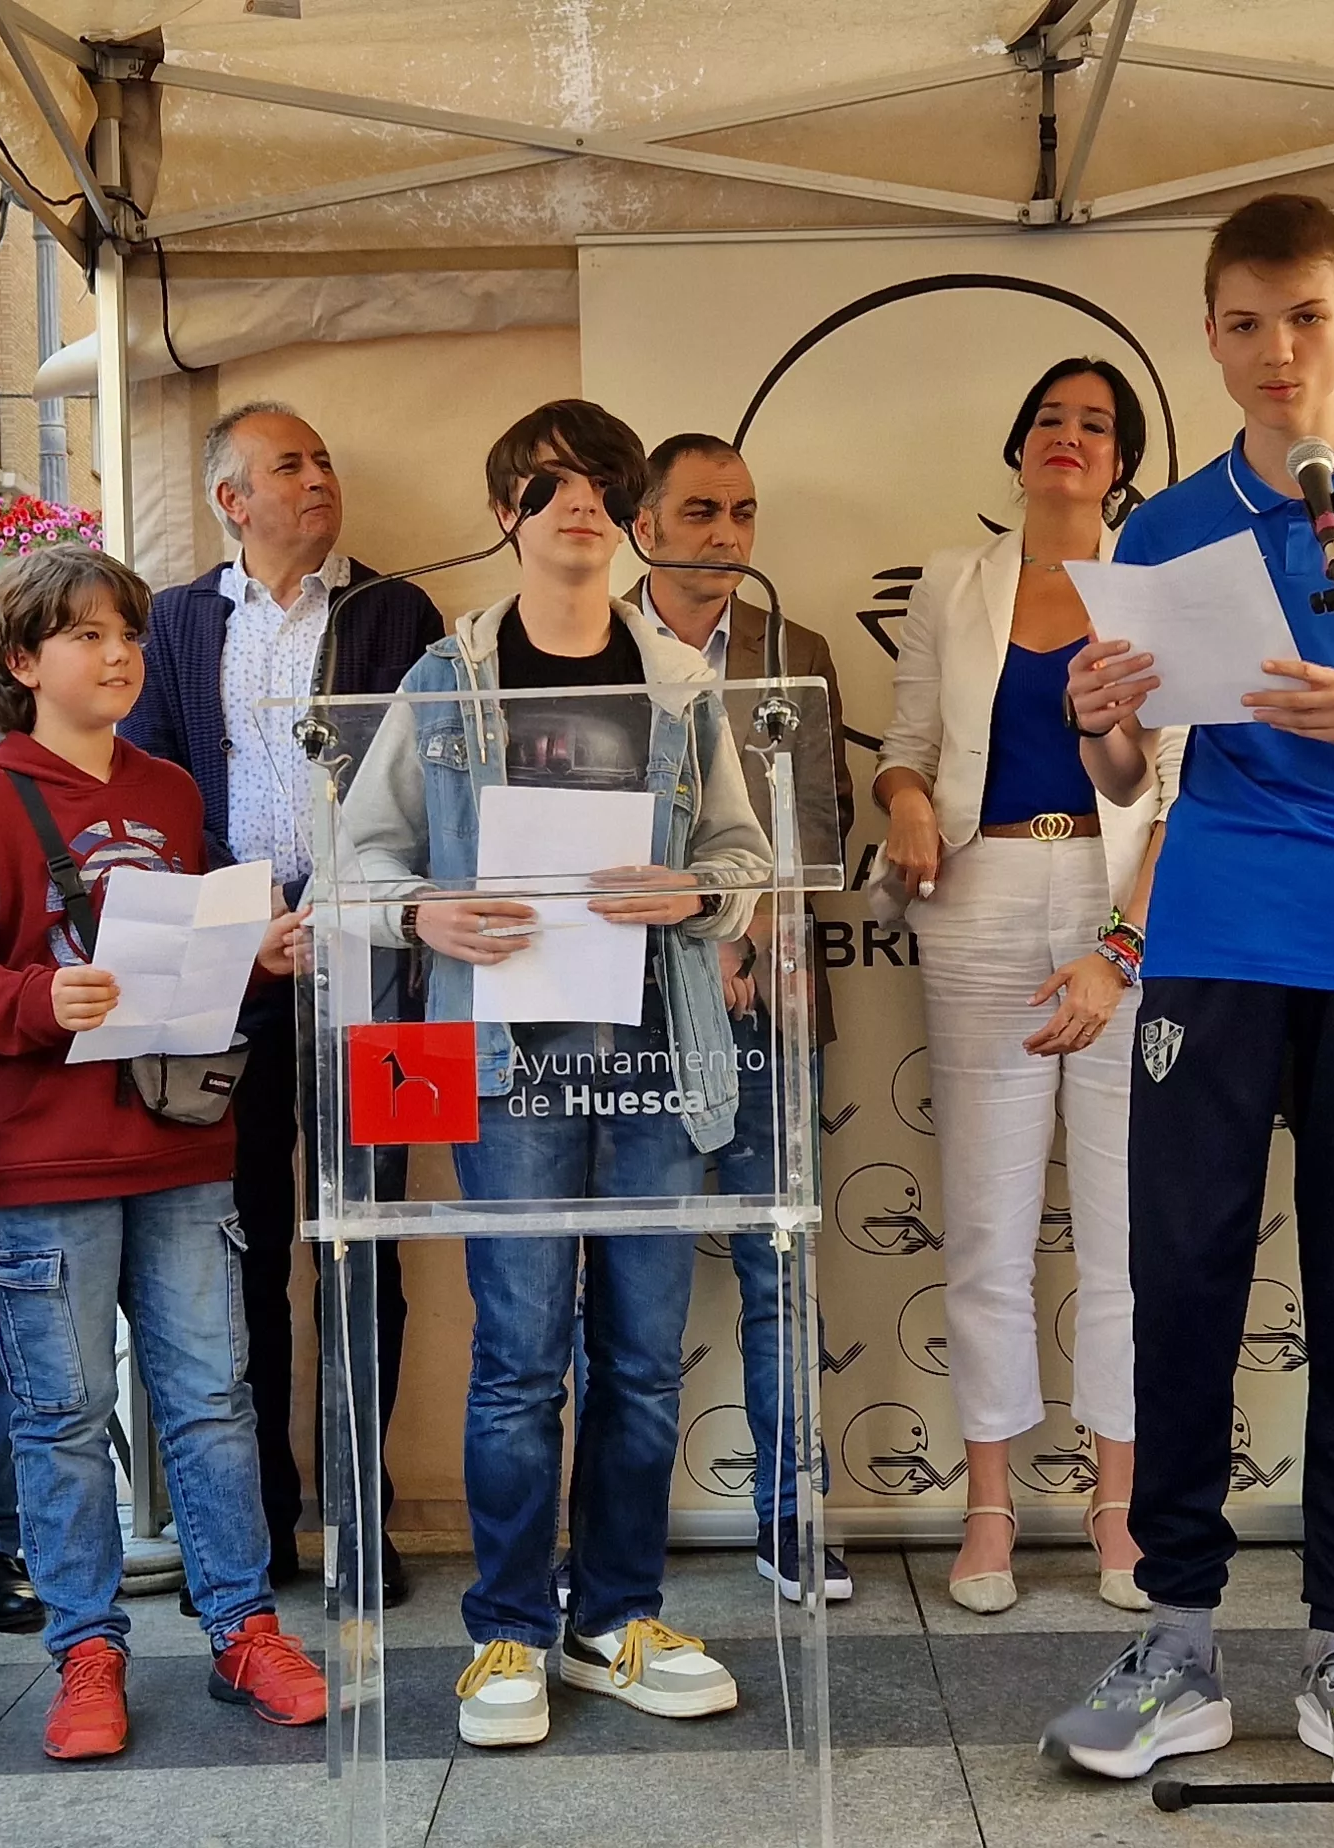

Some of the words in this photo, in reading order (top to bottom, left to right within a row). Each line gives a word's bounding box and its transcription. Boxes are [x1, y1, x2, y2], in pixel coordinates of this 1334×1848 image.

[511, 1045, 766, 1085] Ayuntamiento
[507, 1086, 551, 1117] de
[564, 1084, 705, 1117] Huesca
